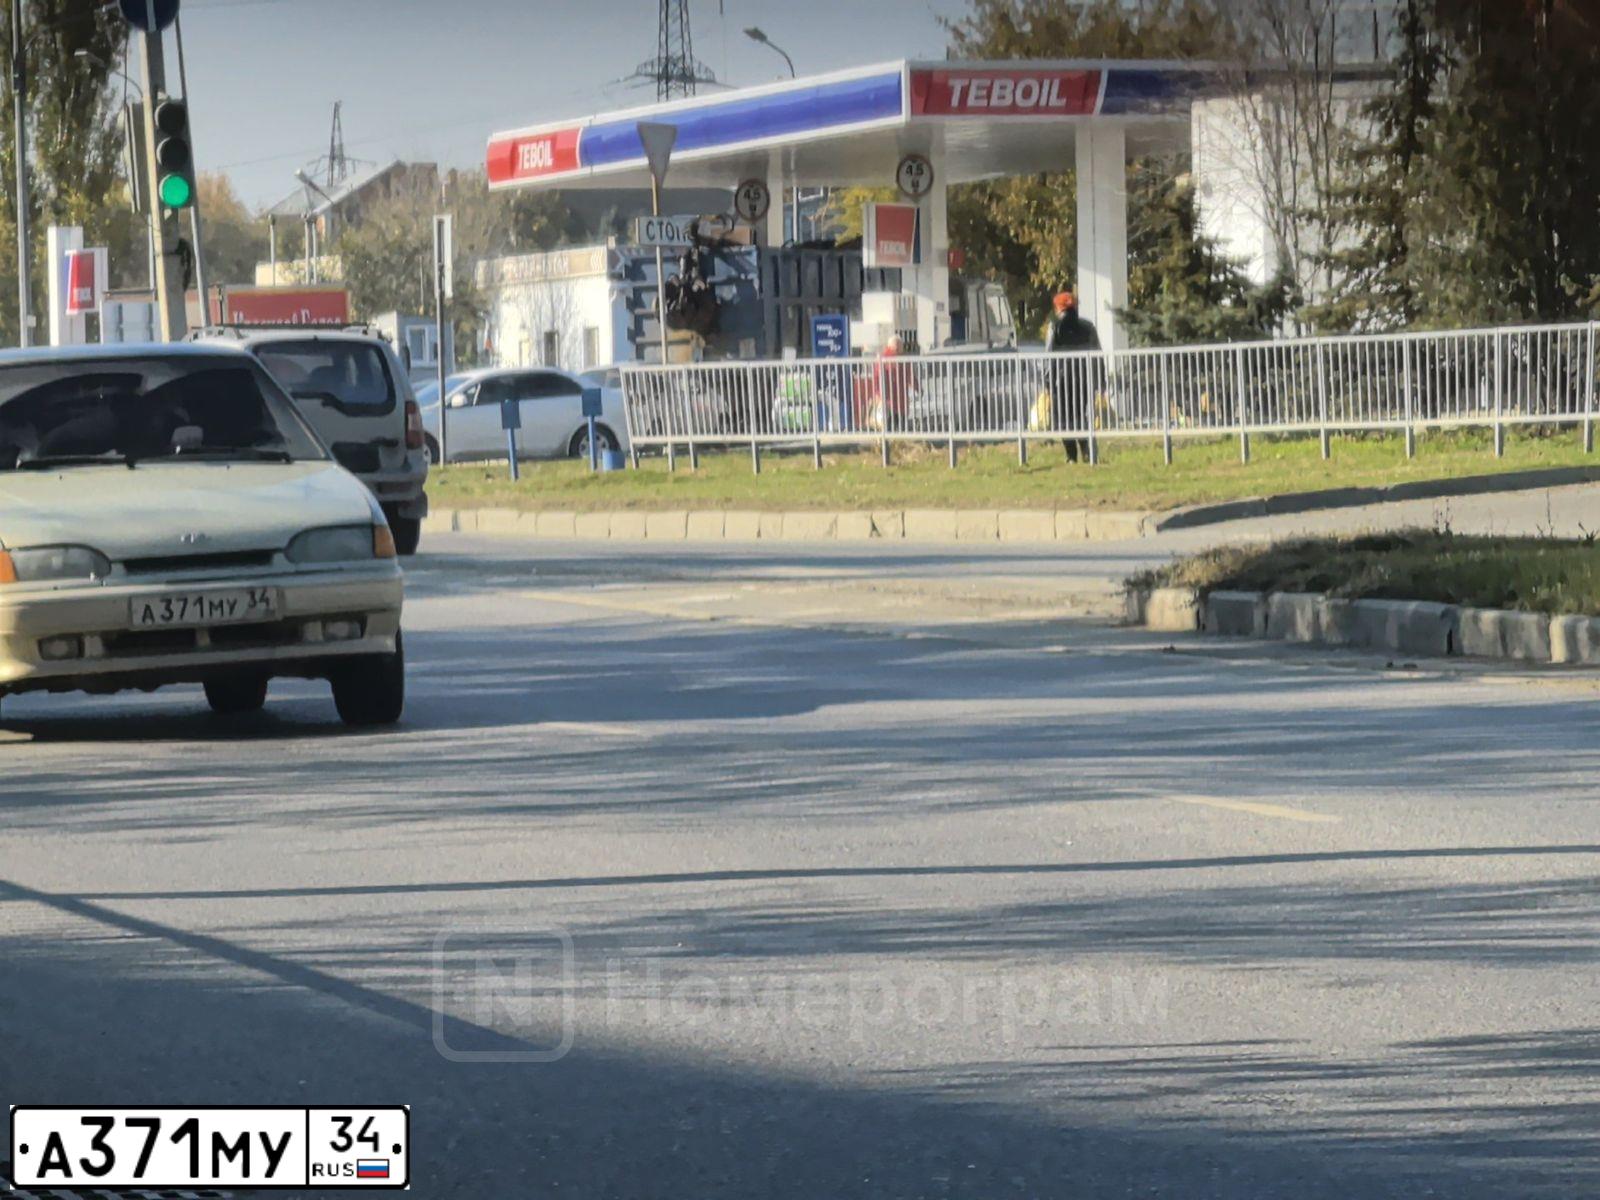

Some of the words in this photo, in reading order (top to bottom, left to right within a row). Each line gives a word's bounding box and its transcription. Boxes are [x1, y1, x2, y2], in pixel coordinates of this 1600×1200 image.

[949, 77, 1067, 108] TEBOIL
[518, 139, 554, 170] TEBOIL
[142, 595, 238, 625] А371МУ
[247, 587, 270, 609] 34
